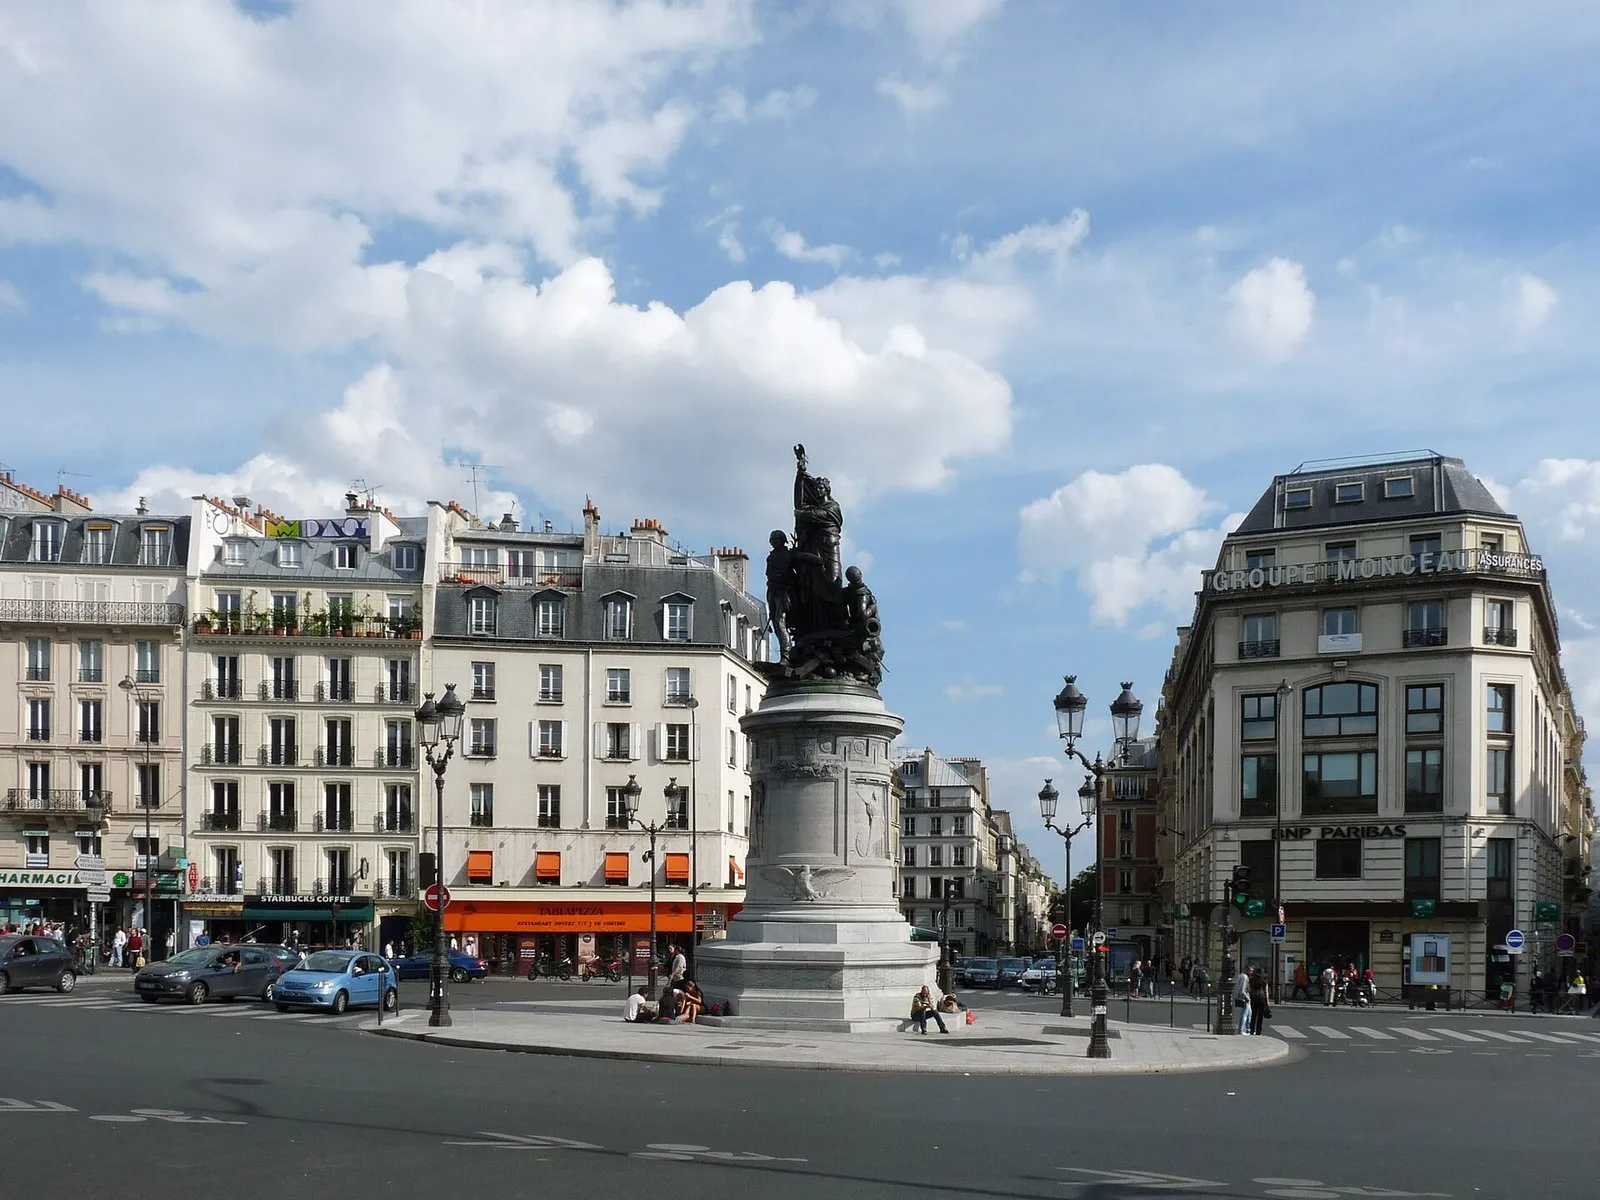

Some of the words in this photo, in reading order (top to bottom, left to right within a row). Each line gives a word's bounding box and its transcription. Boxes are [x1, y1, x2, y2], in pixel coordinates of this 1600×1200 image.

[1480, 554, 1542, 571] ASSURANCES
[1212, 563, 1316, 591] GROUPE
[1337, 550, 1466, 581] MONCEAU
[1271, 827, 1312, 839] BNP
[1321, 825, 1406, 838] PARIBAS
[260, 895, 315, 903] STARBUCKS
[316, 895, 350, 903] COFFEE
[1274, 926, 1282, 935] P
